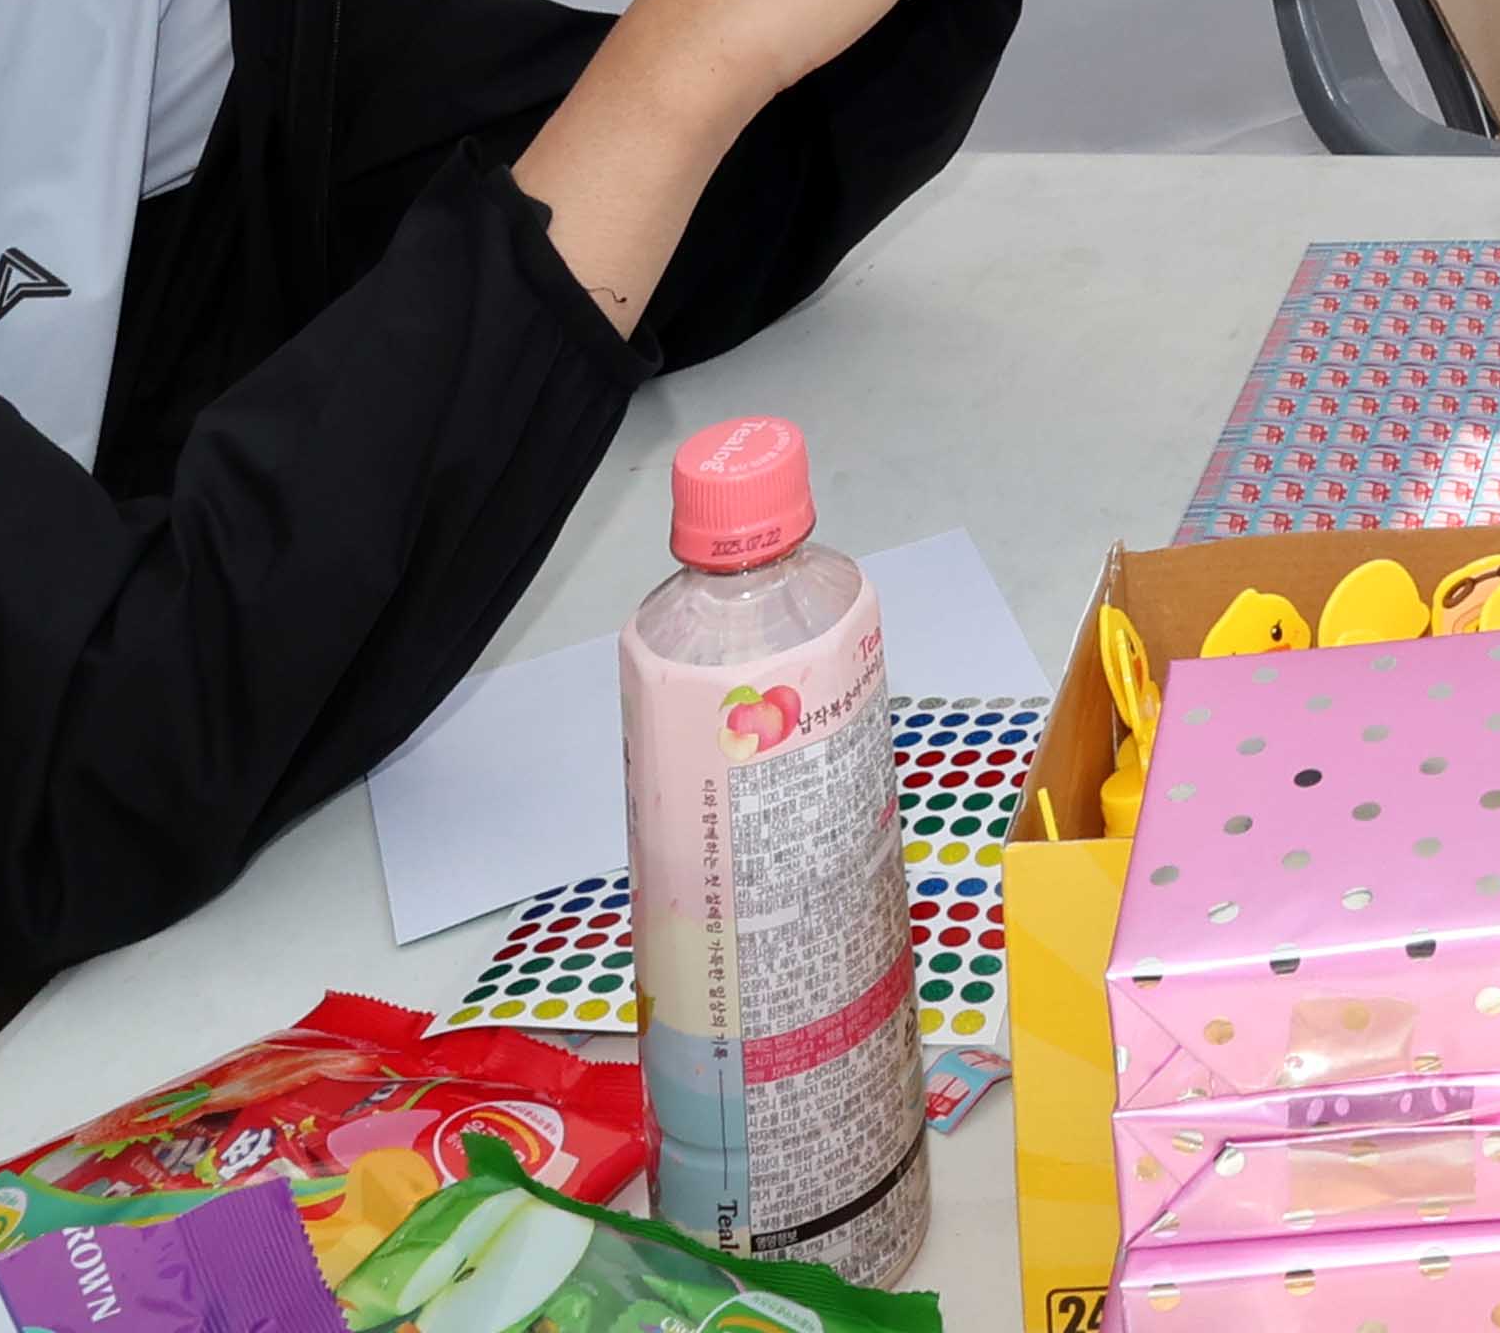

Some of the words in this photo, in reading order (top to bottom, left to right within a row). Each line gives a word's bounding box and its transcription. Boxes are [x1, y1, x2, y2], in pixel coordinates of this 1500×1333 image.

[699, 420, 768, 474] Tealog
[711, 528, 781, 557] 2025.07.22
[797, 678, 861, 735] 납작복숭아
[701, 813, 719, 869] 함께하는
[704, 874, 721, 887] 첫
[708, 940, 725, 981] 가득한
[709, 986, 726, 1027] 일상의
[717, 1199, 741, 1255] Teal
[62, 1225, 122, 1323] ROWN
